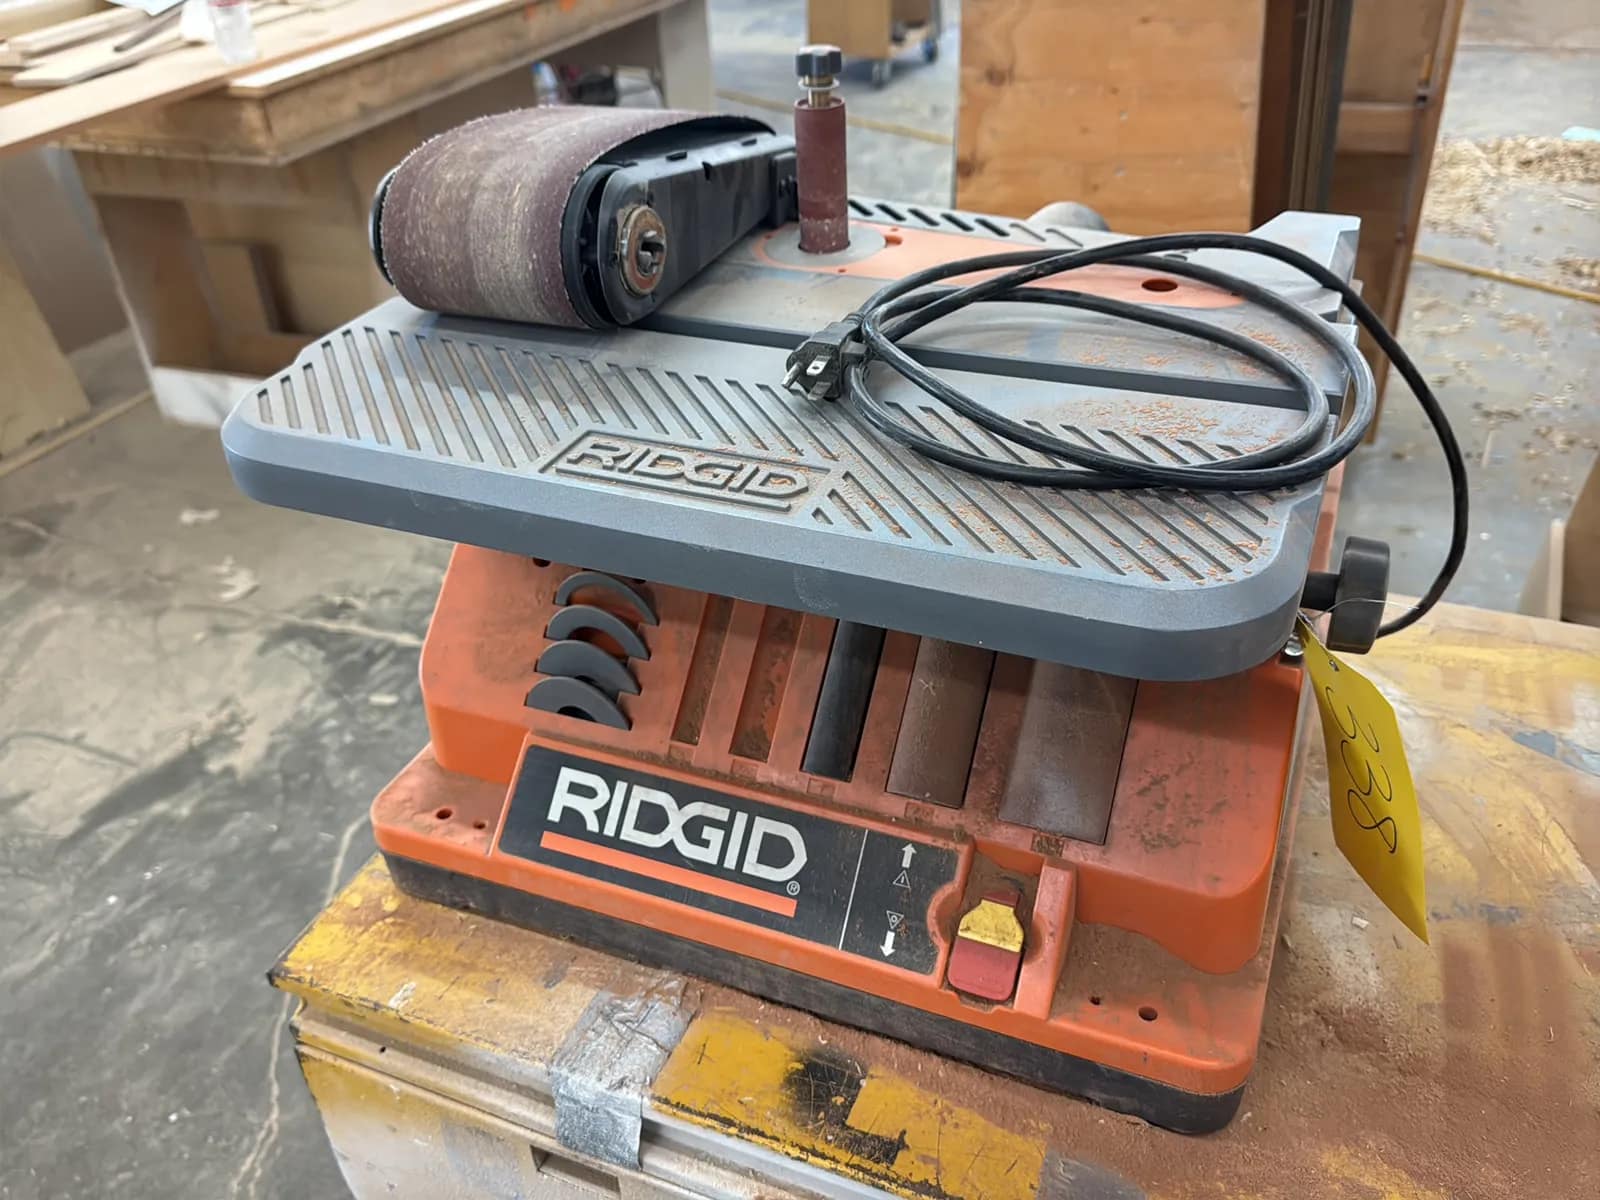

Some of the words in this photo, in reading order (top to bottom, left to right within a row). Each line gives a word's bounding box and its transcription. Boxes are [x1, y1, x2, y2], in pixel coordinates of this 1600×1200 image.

[566, 441, 809, 499] RIDGID
[547, 766, 807, 882] RIDGID
[1325, 685, 1397, 854] 338
